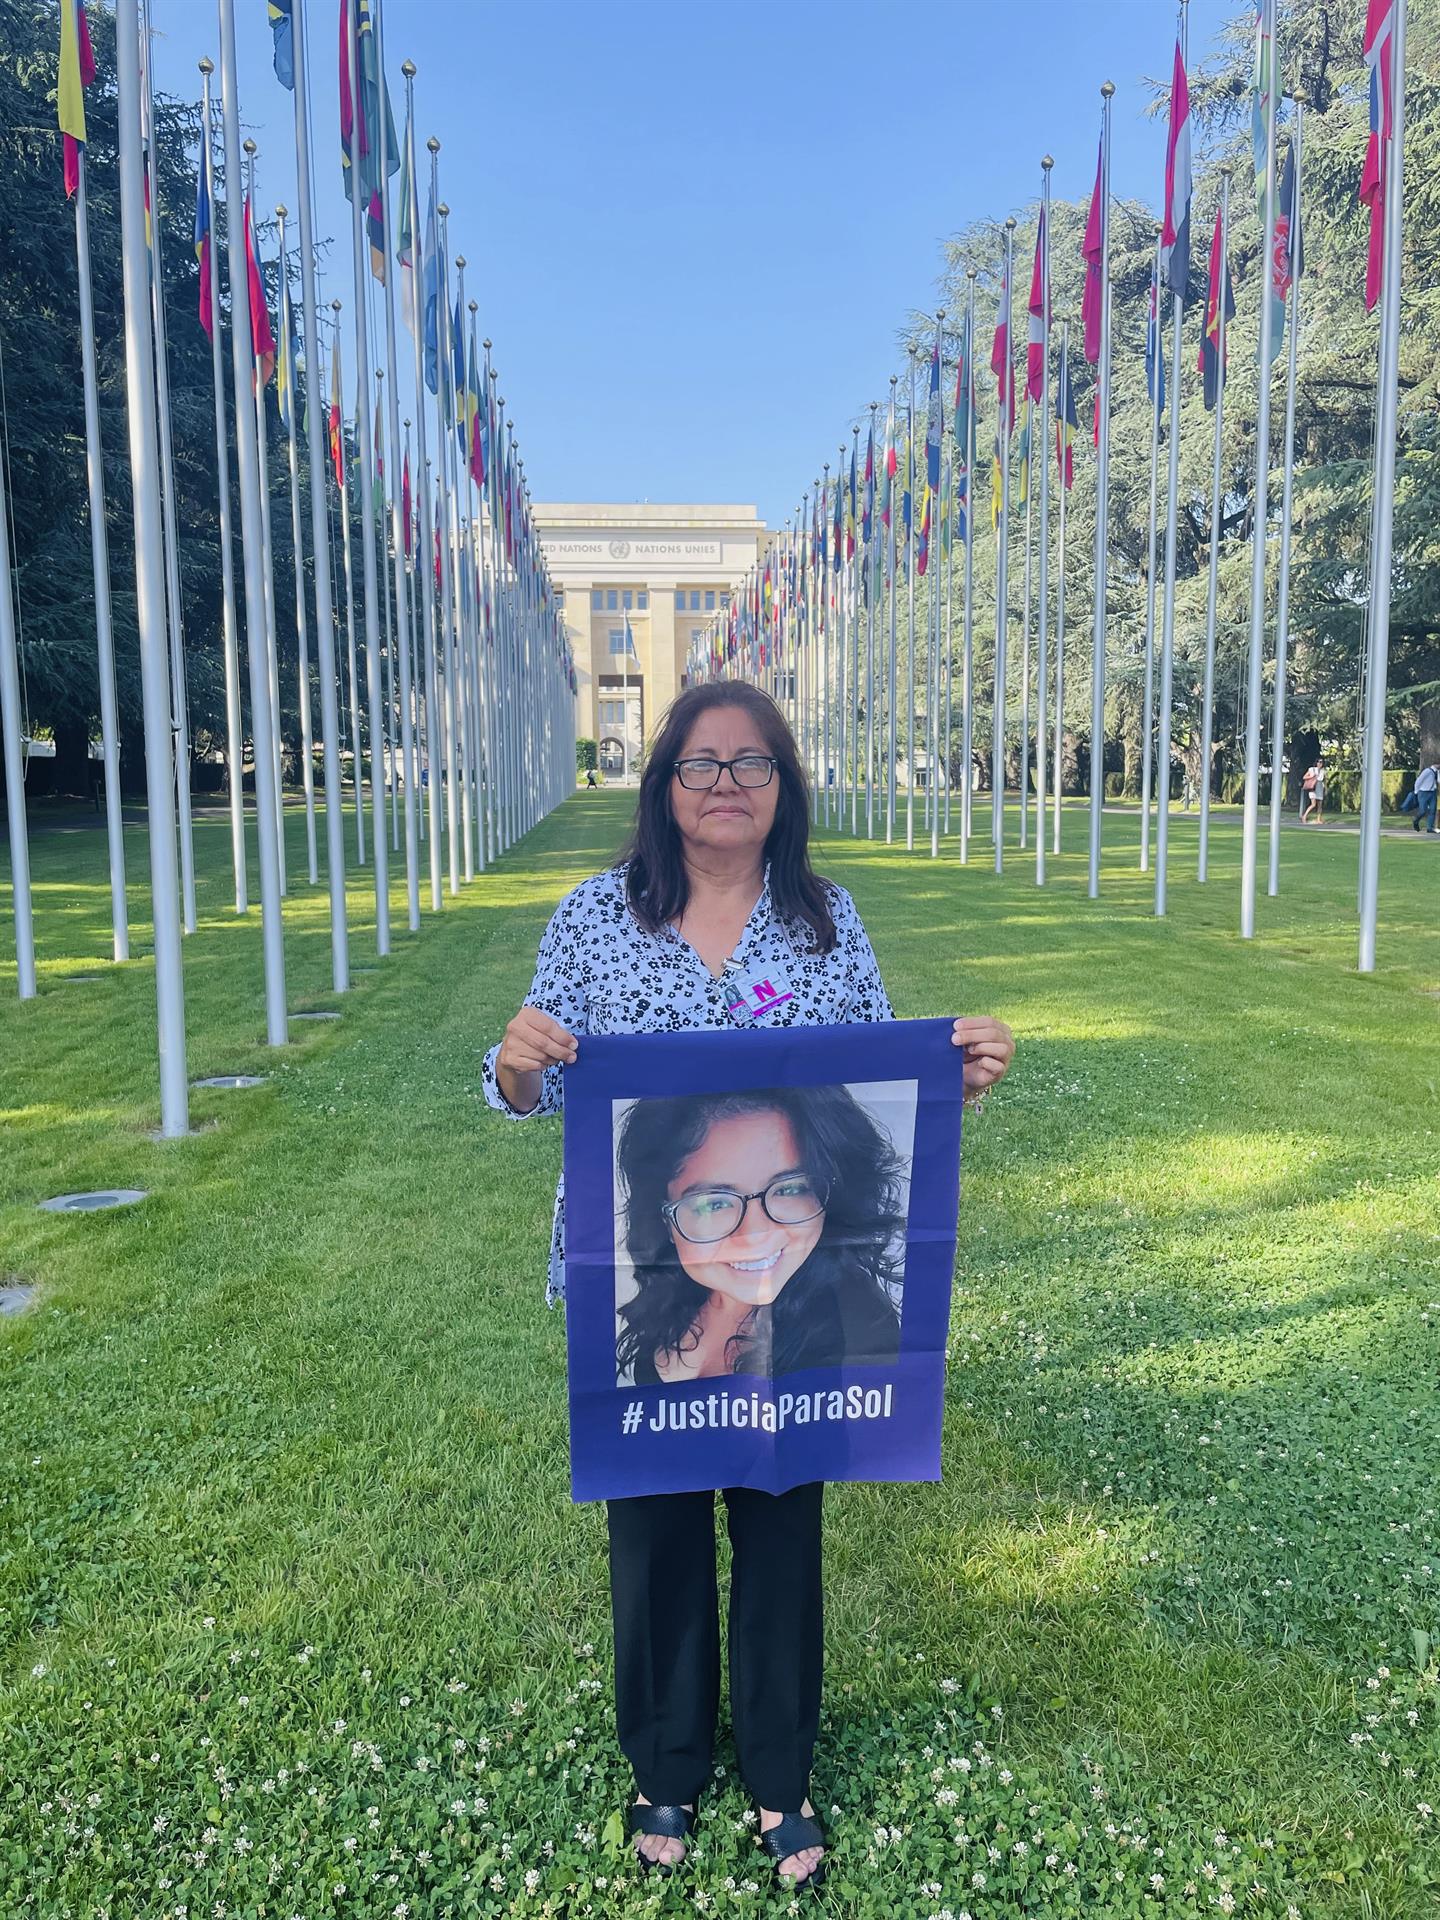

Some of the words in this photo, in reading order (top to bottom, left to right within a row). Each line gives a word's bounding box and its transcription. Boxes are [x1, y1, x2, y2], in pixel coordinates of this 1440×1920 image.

[559, 544, 603, 553] NATIONS
[635, 545, 681, 553] NATIONS
[685, 545, 716, 554] UNIES
[752, 979, 778, 1003] N
